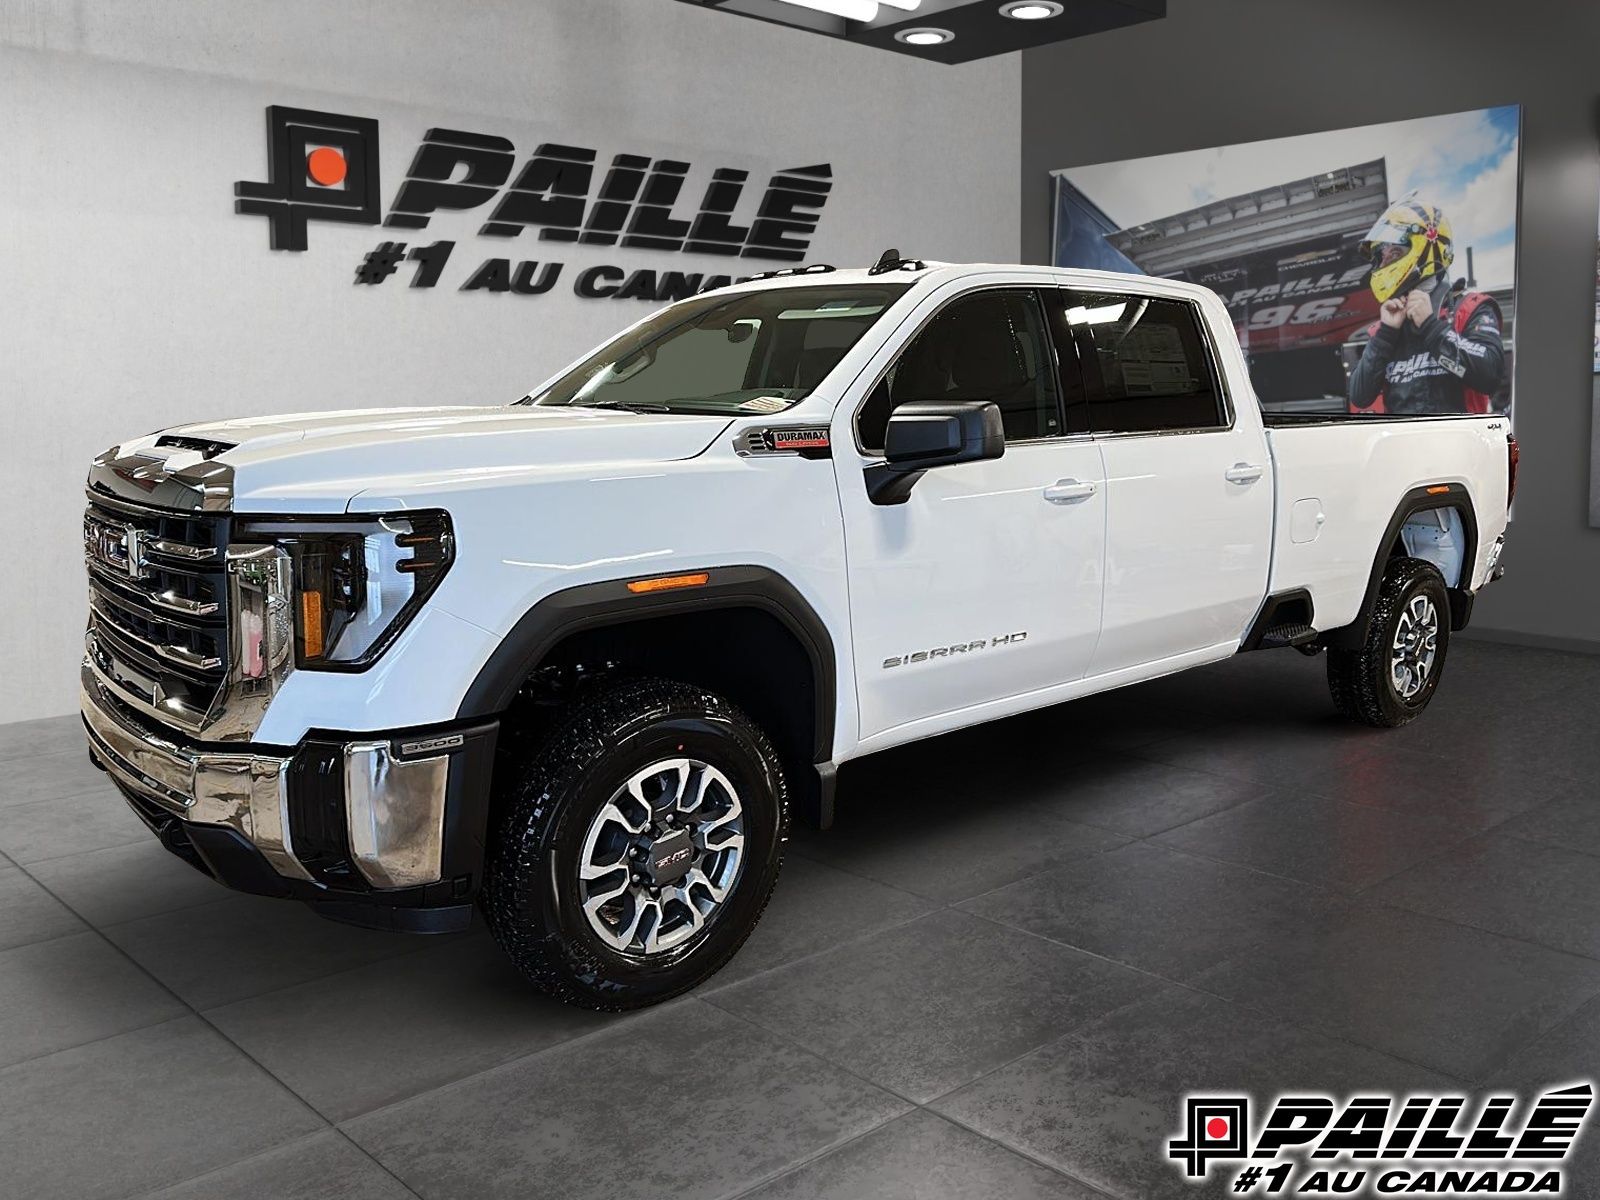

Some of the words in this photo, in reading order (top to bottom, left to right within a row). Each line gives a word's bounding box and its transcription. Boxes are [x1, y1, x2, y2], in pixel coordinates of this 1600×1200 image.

[382, 127, 833, 262] PAILLÉ
[354, 240, 456, 289] #1
[458, 257, 564, 295] AU
[573, 265, 752, 302] CANA
[1277, 255, 1342, 272] CHEVROLET
[1249, 296, 1346, 331] 96
[777, 431, 825, 442] DURAMAX
[882, 640, 987, 669] SIERRA
[991, 631, 1028, 647] HD
